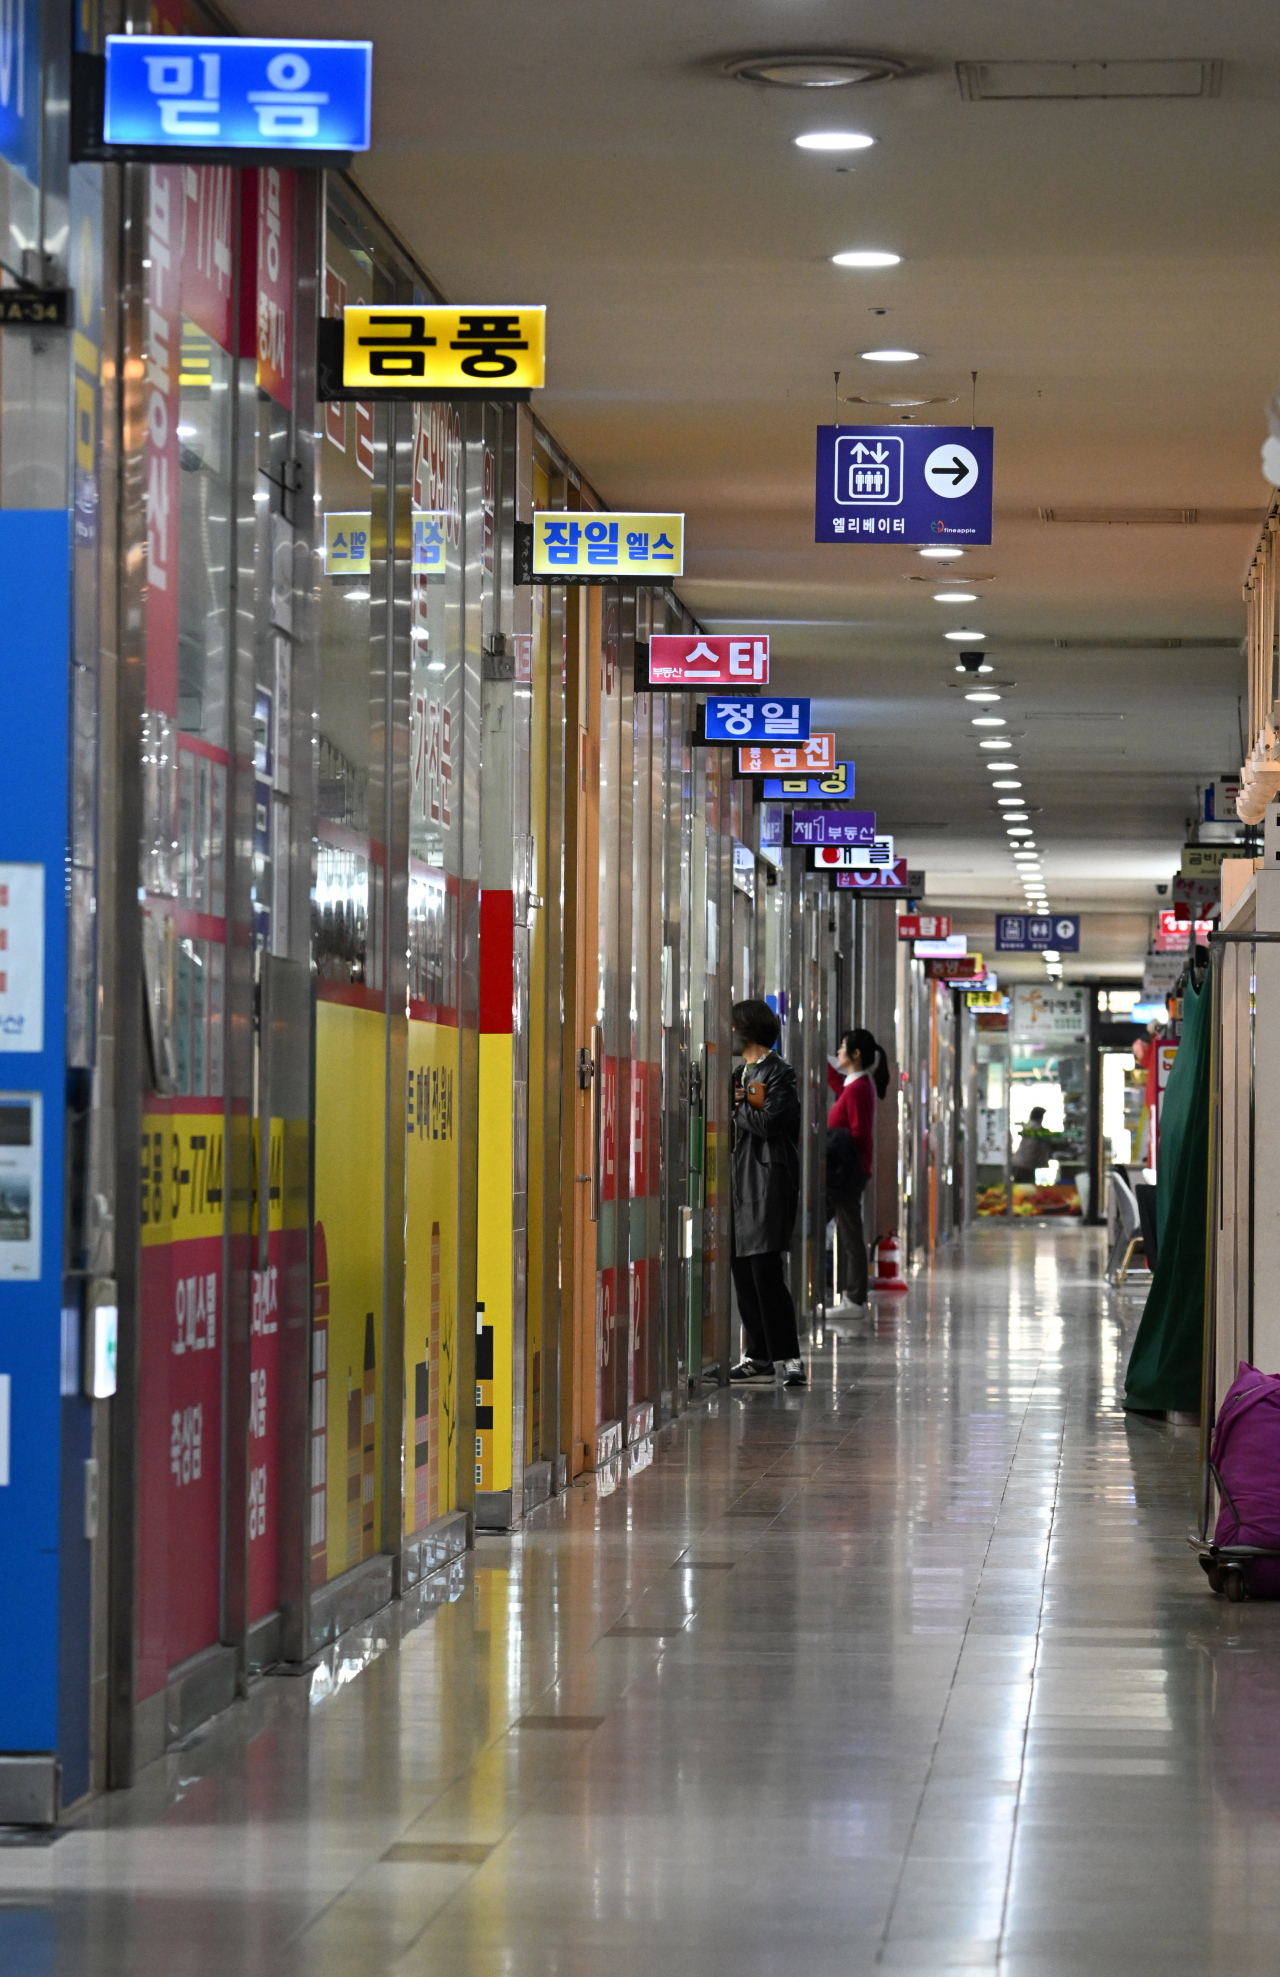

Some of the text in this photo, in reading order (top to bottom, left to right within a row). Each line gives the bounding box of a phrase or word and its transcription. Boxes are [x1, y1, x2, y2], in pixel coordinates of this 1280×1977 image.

[143, 53, 329, 138] 믿음
[358, 315, 529, 378] 금풍
[543, 521, 675, 565] 잠일 엘스
[832, 517, 906, 535] 엘리베이터
[652, 641, 768, 680] 부동산 스타
[716, 702, 800, 736] 정일
[170, 1272, 216, 1356] 오피스텔
